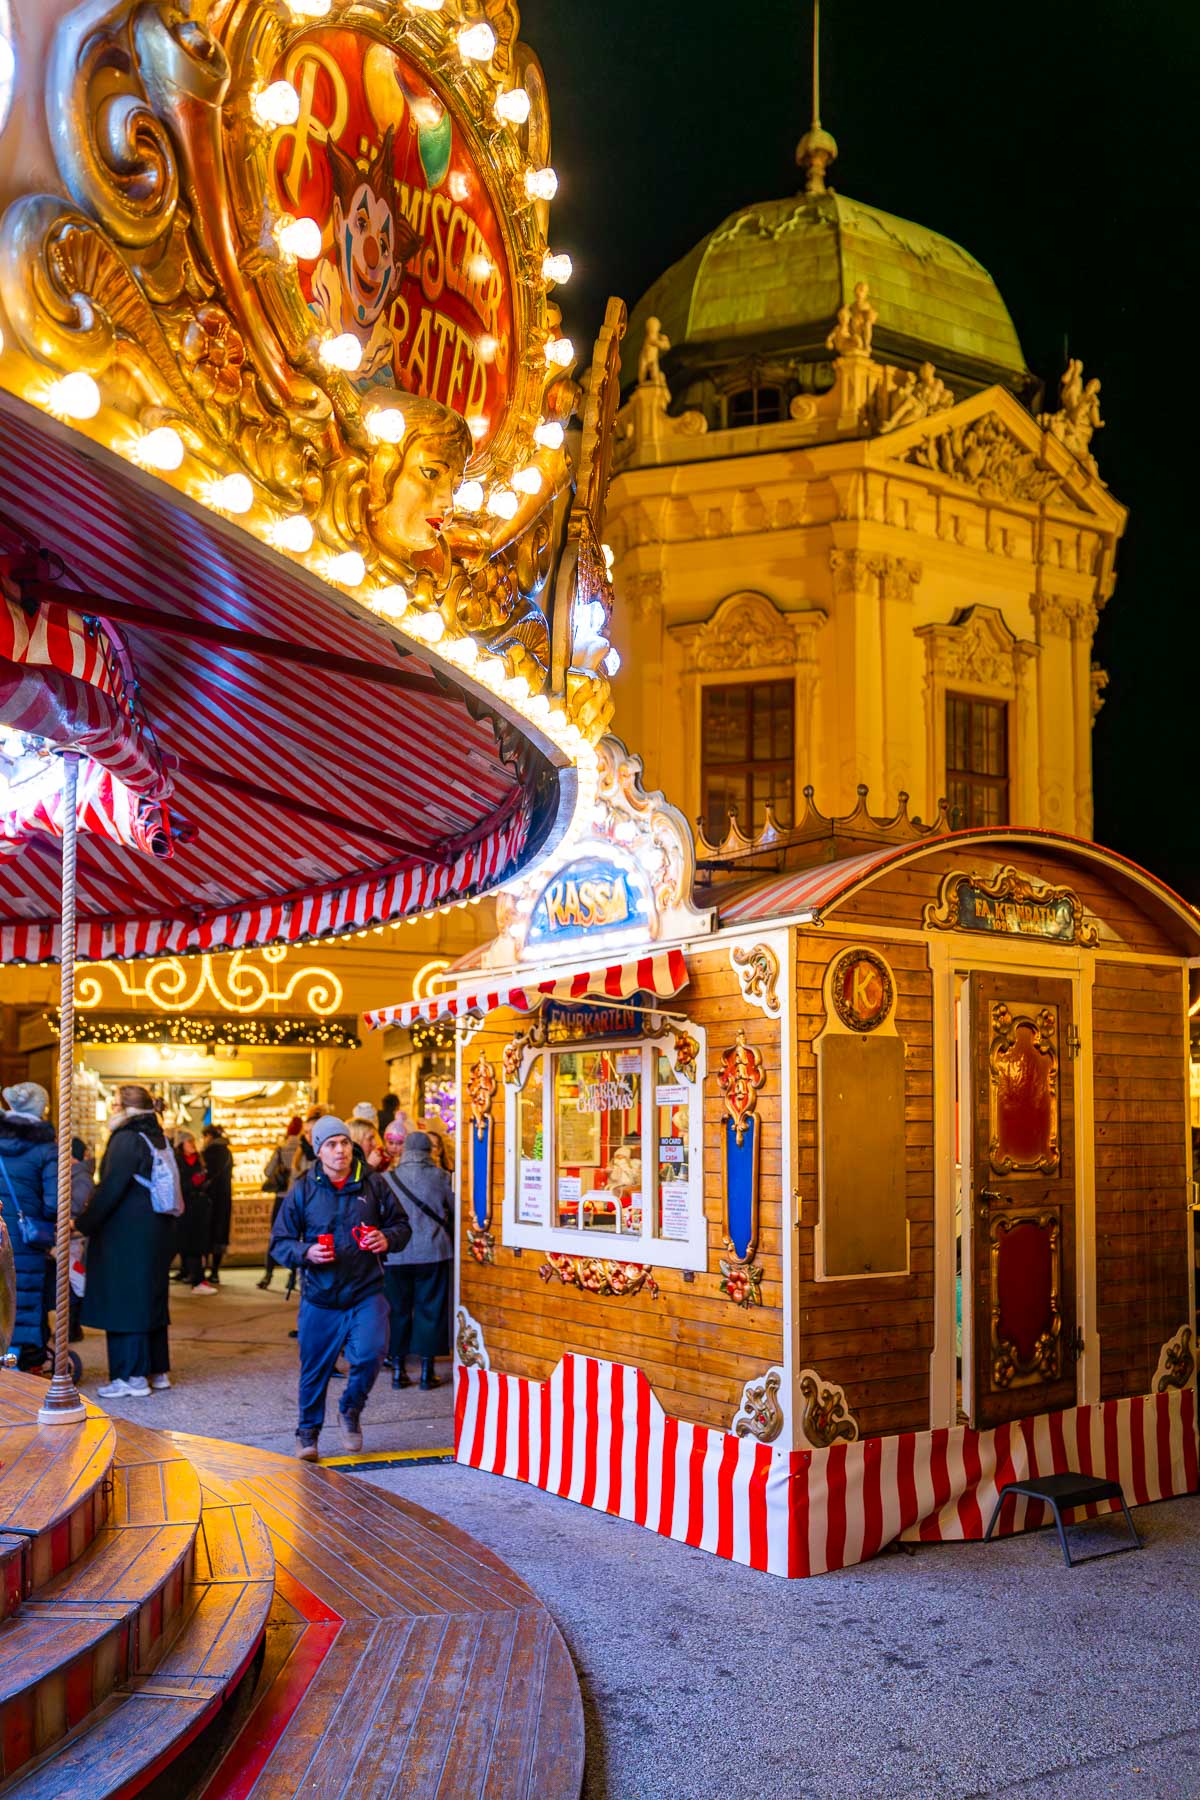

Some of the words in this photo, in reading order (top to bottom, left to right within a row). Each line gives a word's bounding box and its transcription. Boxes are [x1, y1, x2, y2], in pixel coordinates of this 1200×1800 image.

[545, 876, 628, 930] KASSA
[853, 966, 878, 1013] K
[551, 1000, 635, 1034] FAHRKARTEN
[576, 1094, 634, 1113] CHRISTMAS
[584, 1082, 619, 1099] MERRY
